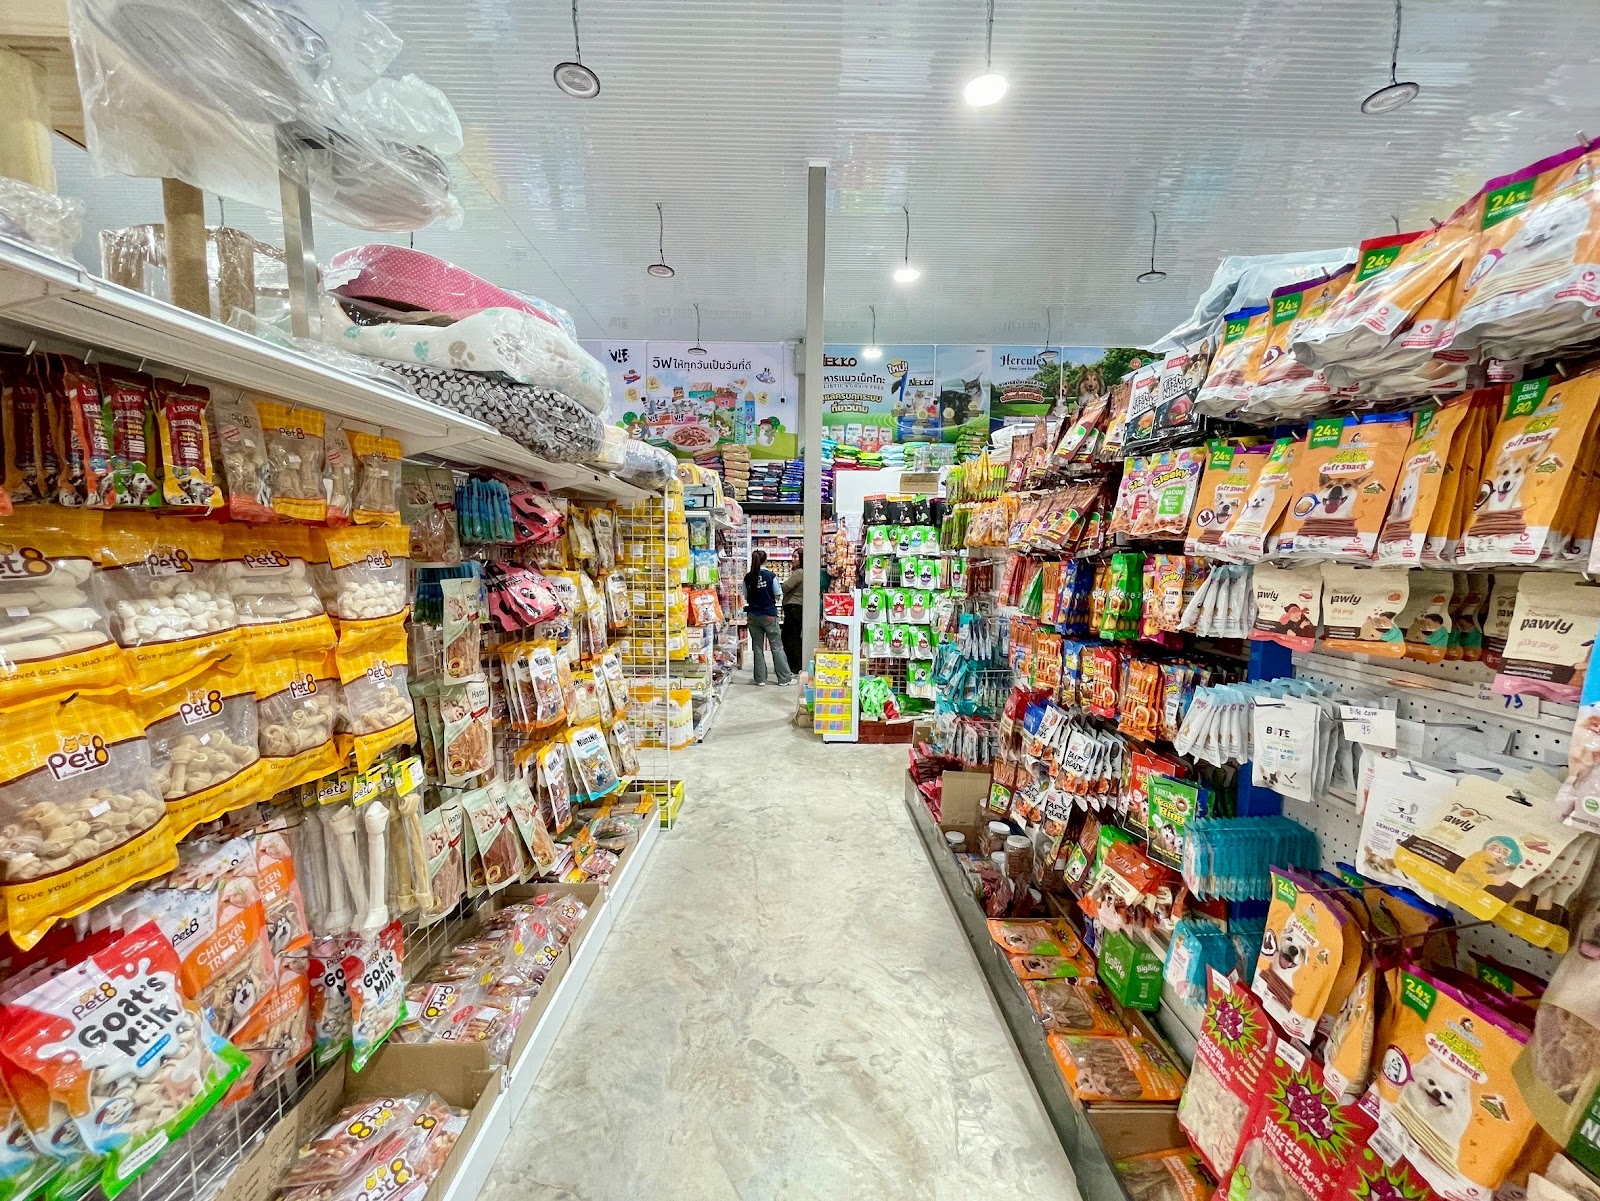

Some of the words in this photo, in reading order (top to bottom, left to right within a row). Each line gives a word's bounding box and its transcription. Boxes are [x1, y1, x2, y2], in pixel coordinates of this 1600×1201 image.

[1491, 190, 1527, 212] 24%
[1276, 299, 1299, 313] 24%
[1229, 323, 1246, 334] 24%
[652, 356, 672, 369] วิฟ
[674, 359, 752, 372] ให้ทุกวันเป็นวันที่ดี
[823, 354, 857, 367] EKKO
[887, 360, 908, 374] ใหม่!
[1000, 353, 1047, 368] Hercules
[1163, 374, 1183, 389] Fish
[1163, 378, 1192, 400] Nibble
[1522, 382, 1539, 392] BIG
[1517, 392, 1538, 403] pack
[279, 427, 305, 440] Pet8
[1315, 425, 1339, 437] 24%
[1214, 450, 1231, 462] 24%
[1322, 464, 1339, 473] Soft
[1341, 462, 1367, 471] Snack
[1152, 468, 1189, 488] Sleeky
[148, 549, 194, 574] Pet8
[245, 550, 290, 568] Pet8
[367, 550, 393, 568] Pet8
[1520, 618, 1574, 634] pawly
[81, 656, 101, 668] snack
[137, 652, 157, 662] Give
[158, 650, 174, 661] your
[368, 661, 393, 683] Pet8
[290, 674, 317, 698] Pet8
[181, 690, 224, 724] Pet8
[1266, 726, 1291, 738] BITE
[1361, 724, 1371, 735] 95
[48, 735, 110, 780] Pet8
[1376, 821, 1400, 835] SENIOR
[17, 890, 44, 902] Give
[47, 880, 72, 895] your
[74, 862, 105, 884] beloved
[107, 852, 126, 867] dogs
[1277, 880, 1296, 896] 24%
[172, 918, 199, 946] Pet8
[197, 920, 247, 965] CHICKEN
[207, 938, 246, 973] TRTS
[1105, 952, 1125, 979] BigBite
[1137, 963, 1160, 974] BigBite
[374, 970, 397, 998] Milk
[1405, 978, 1431, 1004] 24%
[72, 982, 118, 1021] Pet8
[259, 984, 301, 1017] CHICKEN
[427, 986, 454, 1019] Pet8
[265, 998, 297, 1024] TRETS
[1200, 1030, 1226, 1063] CHICKEN
[1427, 1037, 1448, 1055] Soft
[1449, 1052, 1481, 1081] Snack
[1265, 1115, 1312, 1167] CHICKEN
[1262, 1123, 1292, 1160] JERKY
[1297, 1162, 1324, 1192] 100%
